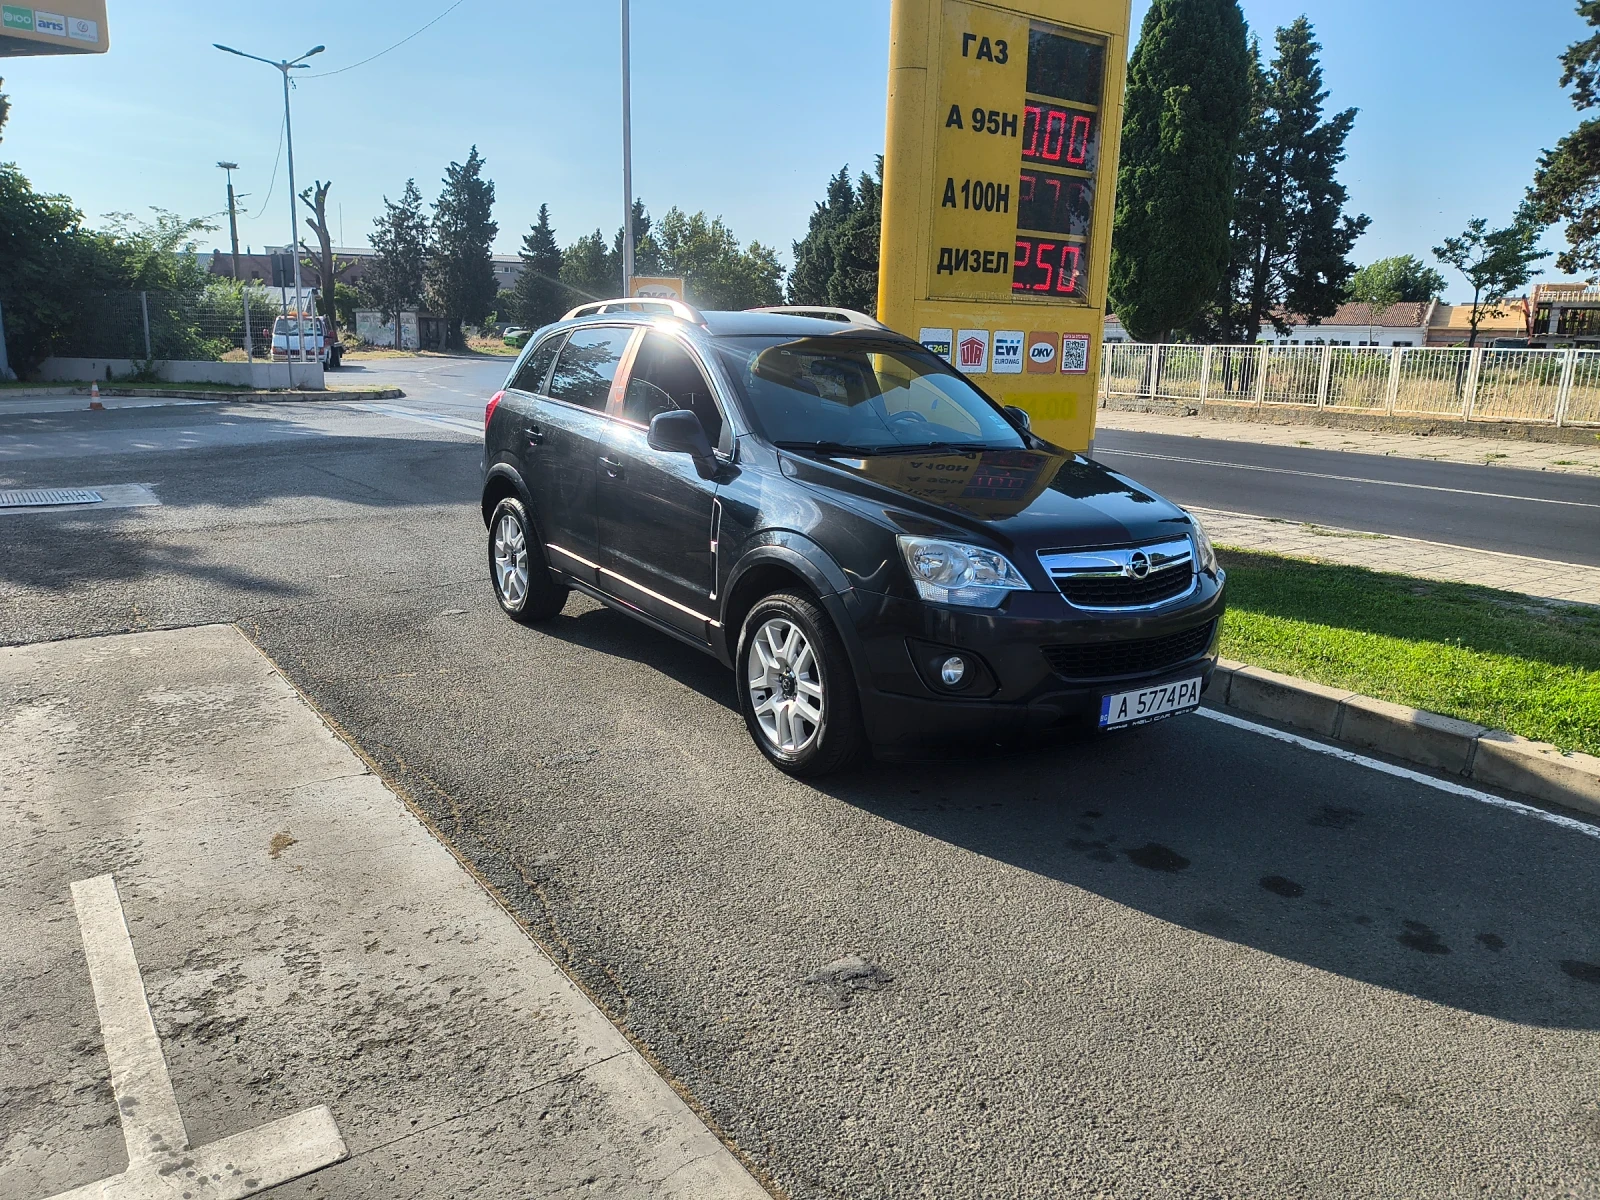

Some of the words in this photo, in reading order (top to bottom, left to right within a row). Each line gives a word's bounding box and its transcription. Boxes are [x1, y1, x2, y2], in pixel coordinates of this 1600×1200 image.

[962, 32, 1009, 65] ГАЗ
[945, 104, 964, 129] А
[971, 107, 1018, 137] 95Н
[961, 179, 1010, 213] 100Н
[936, 247, 1009, 275] ДИЗЕЛ
[1031, 347, 1054, 357] DKV
